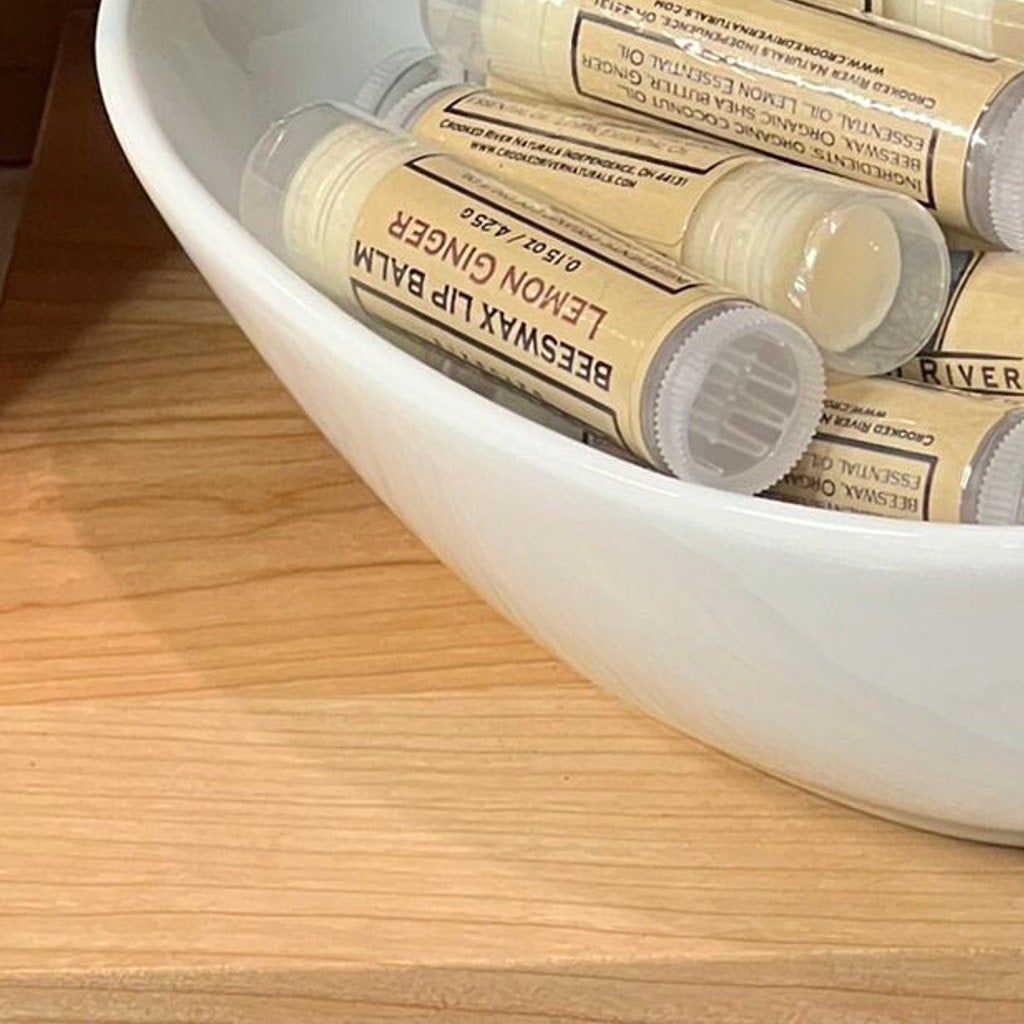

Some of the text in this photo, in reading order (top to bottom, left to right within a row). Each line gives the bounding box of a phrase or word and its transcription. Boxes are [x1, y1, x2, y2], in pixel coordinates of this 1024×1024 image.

[579, 53, 643, 86] GINGER
[647, 54, 735, 94] ESSENTIAL
[761, 46, 827, 77] NATURALS
[831, 68, 870, 90] RIVER
[713, 95, 757, 119] SHEA
[737, 81, 797, 112] LEMON
[872, 81, 936, 110] CROOKED
[650, 94, 730, 130] COCONUT
[758, 109, 837, 147] ORGANIC
[733, 121, 805, 153] ORGANIC
[836, 112, 924, 150] ESSENTIAL
[467, 209, 511, 242] 4.25
[385, 208, 500, 288] GINGER
[542, 245, 581, 275] 0.15
[346, 239, 431, 298] BALM
[428, 279, 478, 322] LIP
[498, 264, 608, 341] LEMON
[472, 301, 618, 391] BEESWAX
[918, 358, 1022, 389] RIVER
[834, 415, 871, 433] RIVER
[872, 423, 935, 447] CROOKED
[837, 459, 921, 490] ESSENTIAL
